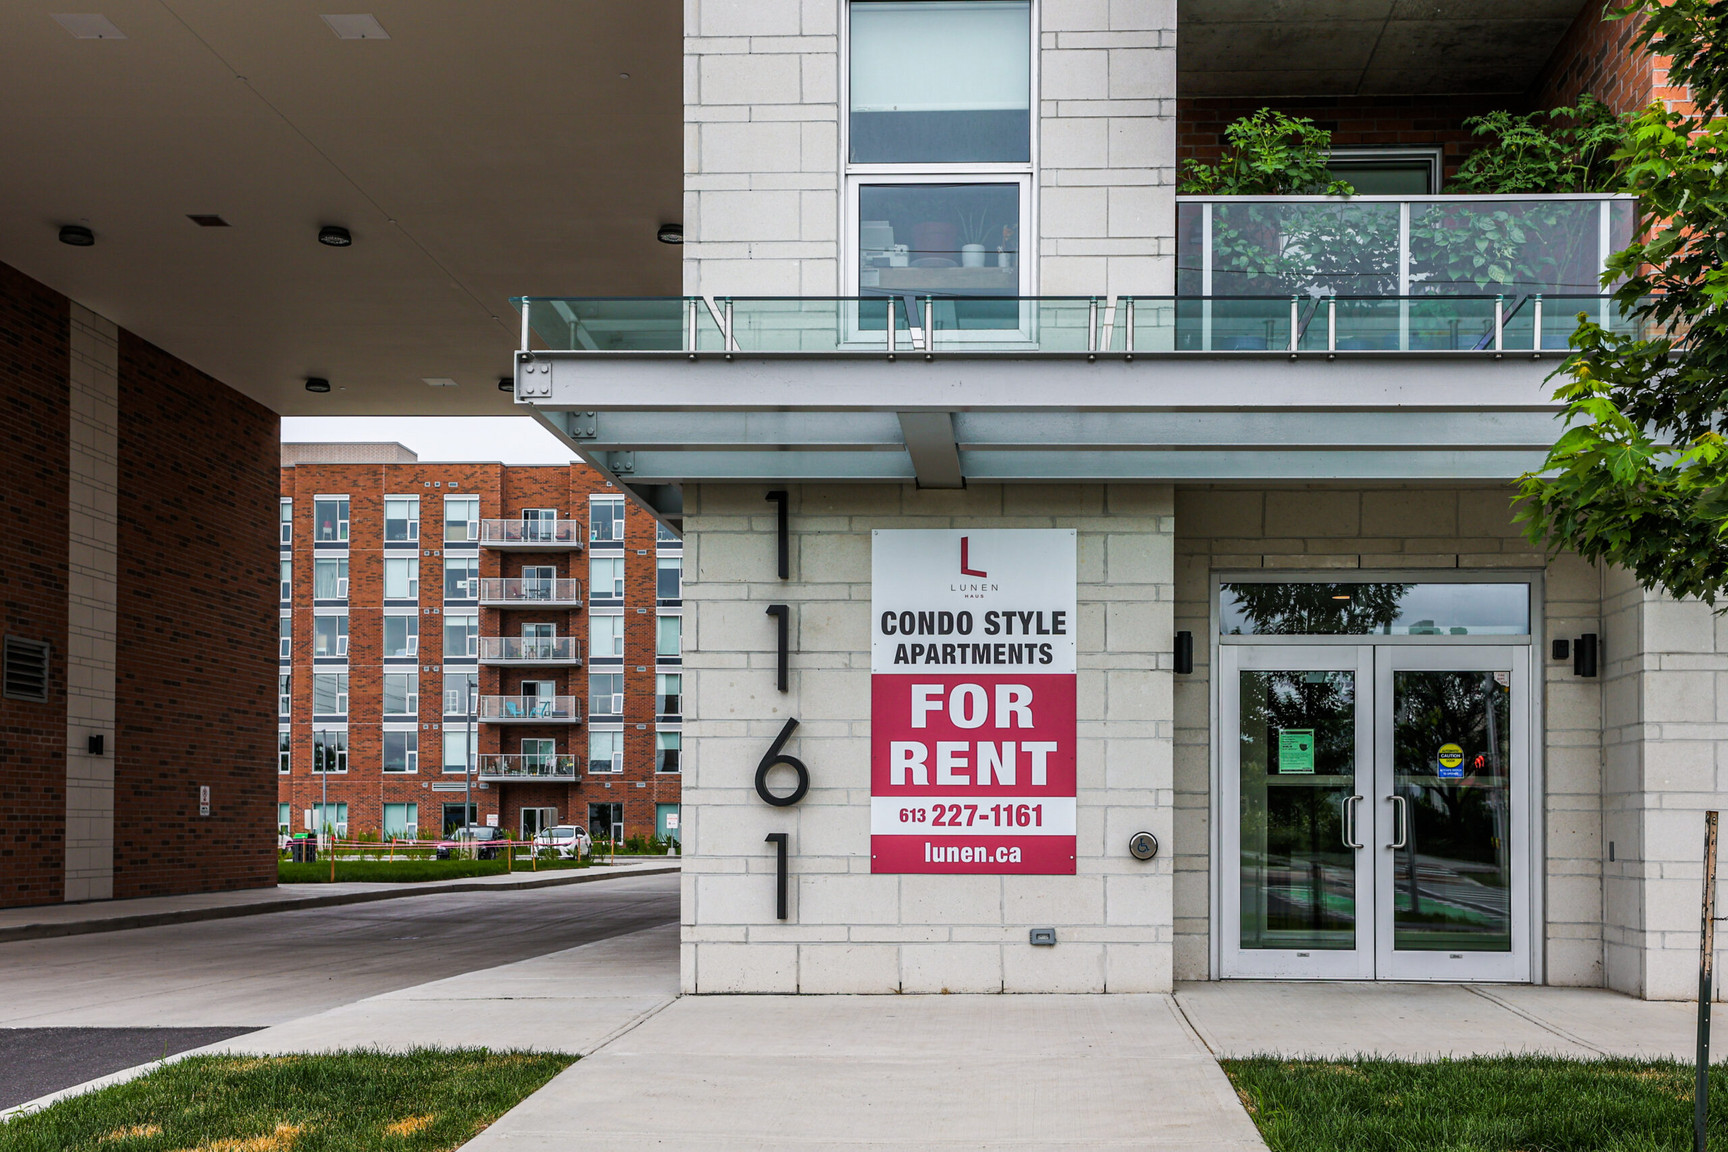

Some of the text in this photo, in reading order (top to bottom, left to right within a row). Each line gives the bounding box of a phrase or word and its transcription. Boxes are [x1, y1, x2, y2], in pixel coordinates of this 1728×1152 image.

[881, 610, 1067, 636] CONDO STYLE
[894, 643, 1053, 665] APARTMENTS
[911, 683, 1035, 729] FOR
[890, 741, 1058, 786] RENT
[899, 804, 1043, 827] 613 227-1161
[924, 842, 1022, 863] lunen.ca
